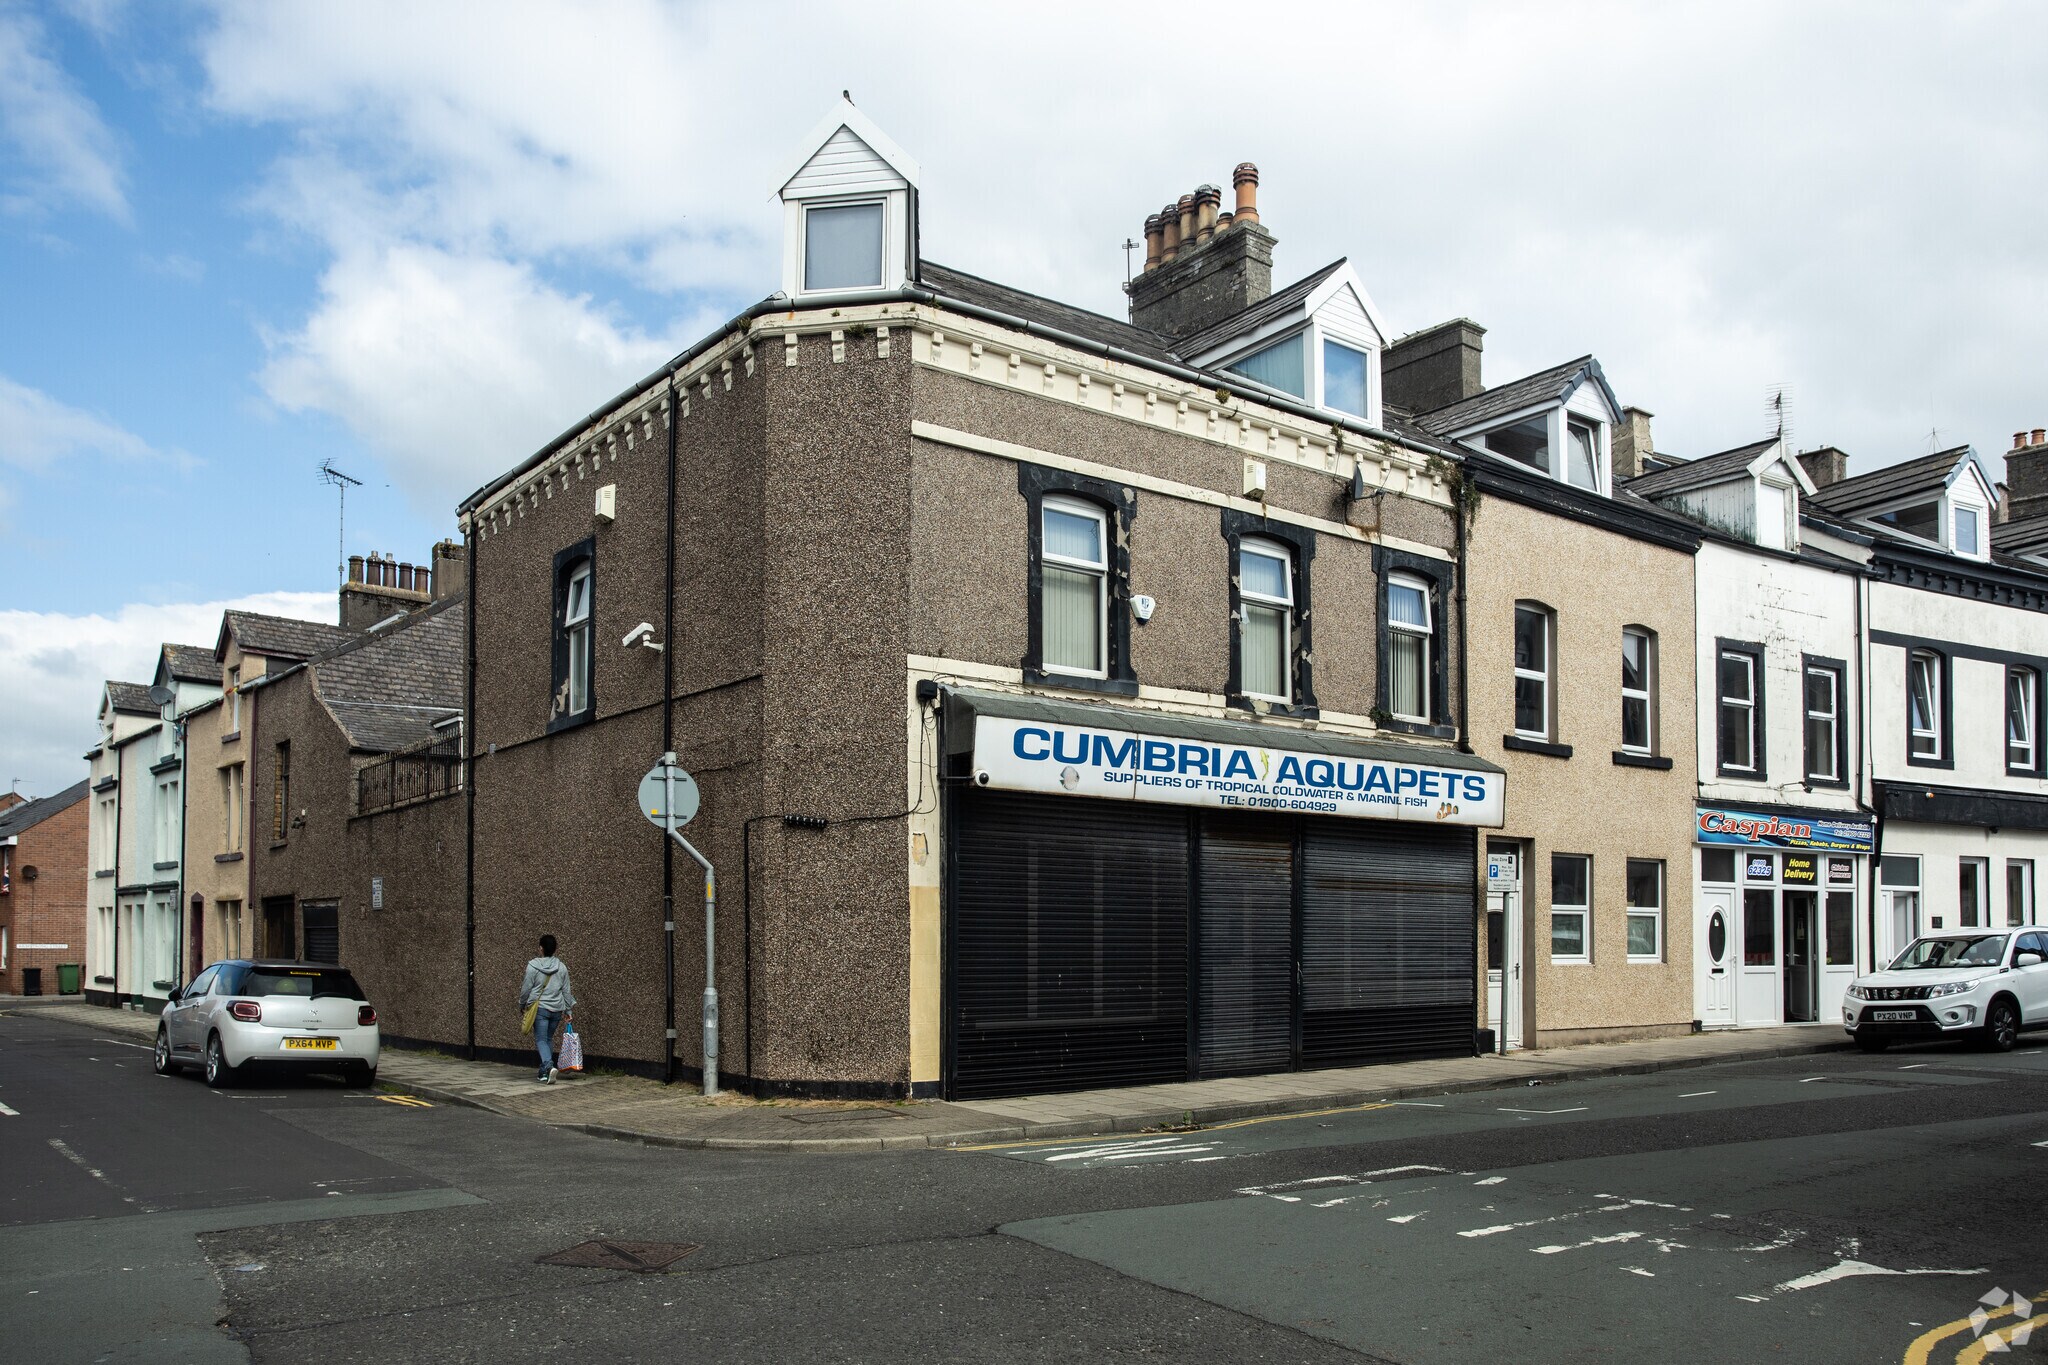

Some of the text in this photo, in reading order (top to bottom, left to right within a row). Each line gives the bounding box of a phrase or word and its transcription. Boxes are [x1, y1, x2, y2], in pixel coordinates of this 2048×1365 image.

[1013, 727, 1486, 802] CUMBRIA AQUAPETS
[1103, 771, 1428, 808] SUPPLIERS OF TROPICAL COLDWATER & MARINE FISH
[1219, 794, 1337, 813] TEL: 01900-604929
[1699, 811, 1812, 842] Caspian
[1817, 820, 1831, 828] Home
[1832, 821, 1851, 831] Delivery
[1830, 842, 1850, 850] Burgers
[1789, 858, 1810, 868] Home
[1748, 865, 1772, 876] 62325
[1784, 868, 1815, 881] Delivery
[1876, 1012, 1897, 1020] PX20
[289, 1040, 333, 1049] PX64 MVP
